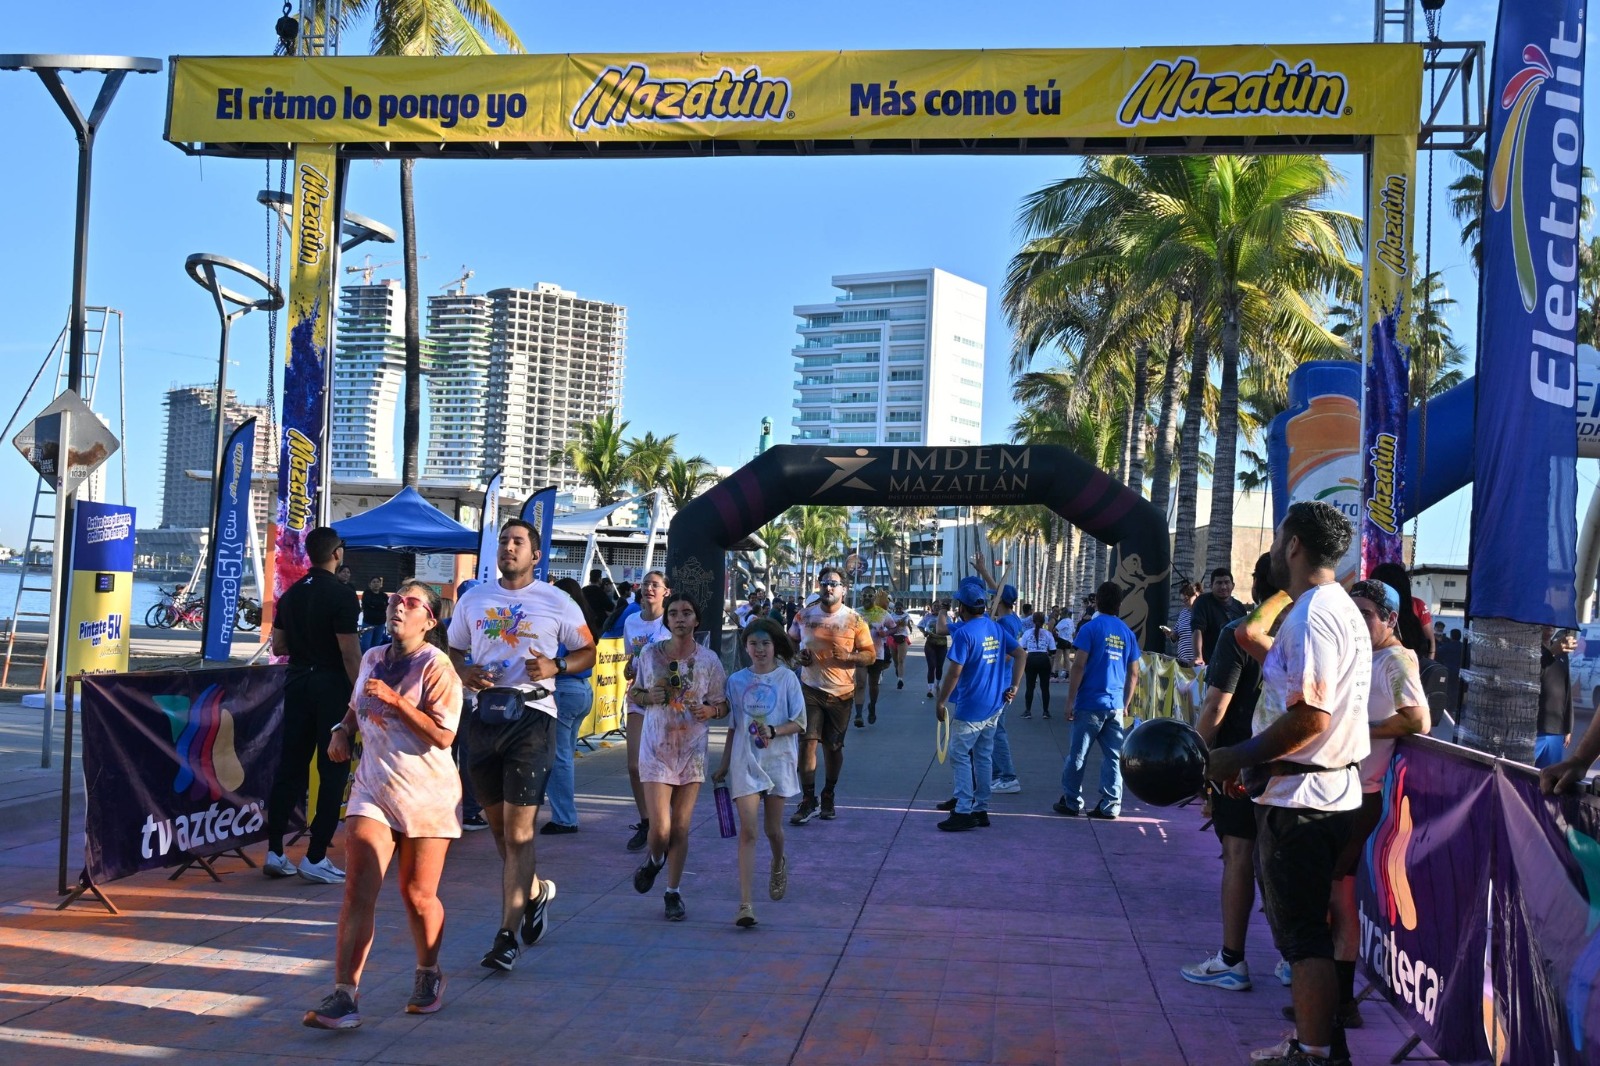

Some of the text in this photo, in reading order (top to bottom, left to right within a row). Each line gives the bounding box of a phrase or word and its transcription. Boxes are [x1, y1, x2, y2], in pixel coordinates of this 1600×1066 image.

[215, 86, 528, 129] El ritmo lo pongo yo
[571, 63, 792, 131] Mazatún
[850, 79, 1061, 117] Más como tú
[1118, 57, 1347, 127] Mazatún
[299, 163, 330, 265] Mazatún
[1376, 174, 1408, 276] Mazatún
[1530, 21, 1583, 408] Electrolit
[286, 428, 317, 532] Mazatún
[889, 469, 1029, 492] MAZATLÁN
[891, 447, 1031, 471] IMDEM
[1367, 432, 1398, 535] Mazatún
[217, 542, 243, 579] 5K
[92, 637, 102, 647] con
[107, 614, 122, 640] 5K
[175, 801, 265, 851] azteca
[1373, 929, 1439, 1026] azteca
